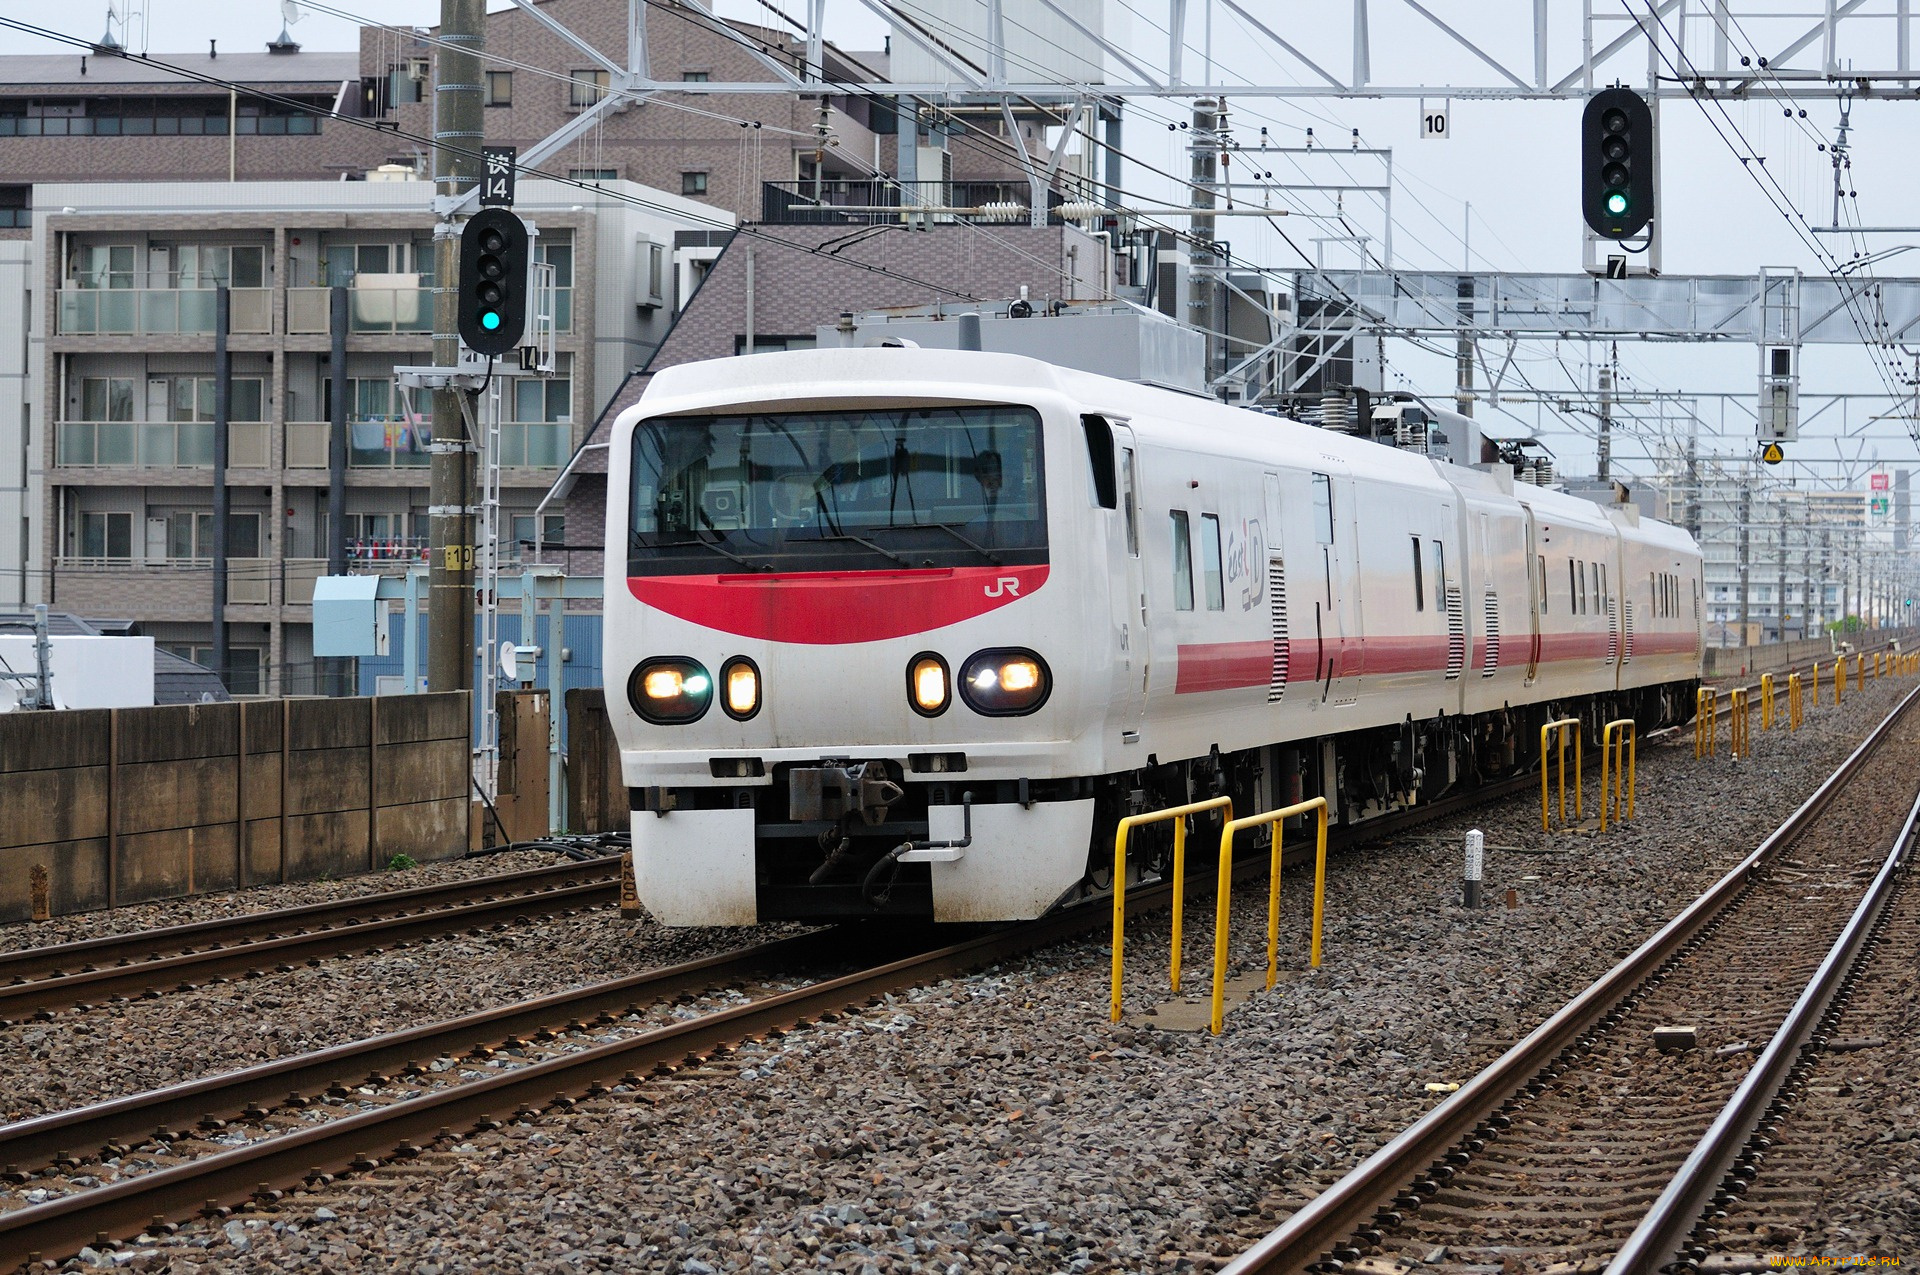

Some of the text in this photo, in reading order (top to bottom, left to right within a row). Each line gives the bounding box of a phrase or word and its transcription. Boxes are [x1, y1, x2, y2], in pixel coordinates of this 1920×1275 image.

[1425, 114, 1445, 133] 10
[487, 177, 507, 198] 14
[1609, 256, 1624, 278] 7
[521, 347, 536, 368] 14
[1769, 450, 1777, 459] 6
[984, 576, 1020, 598] JR
[1119, 623, 1130, 651] JR
